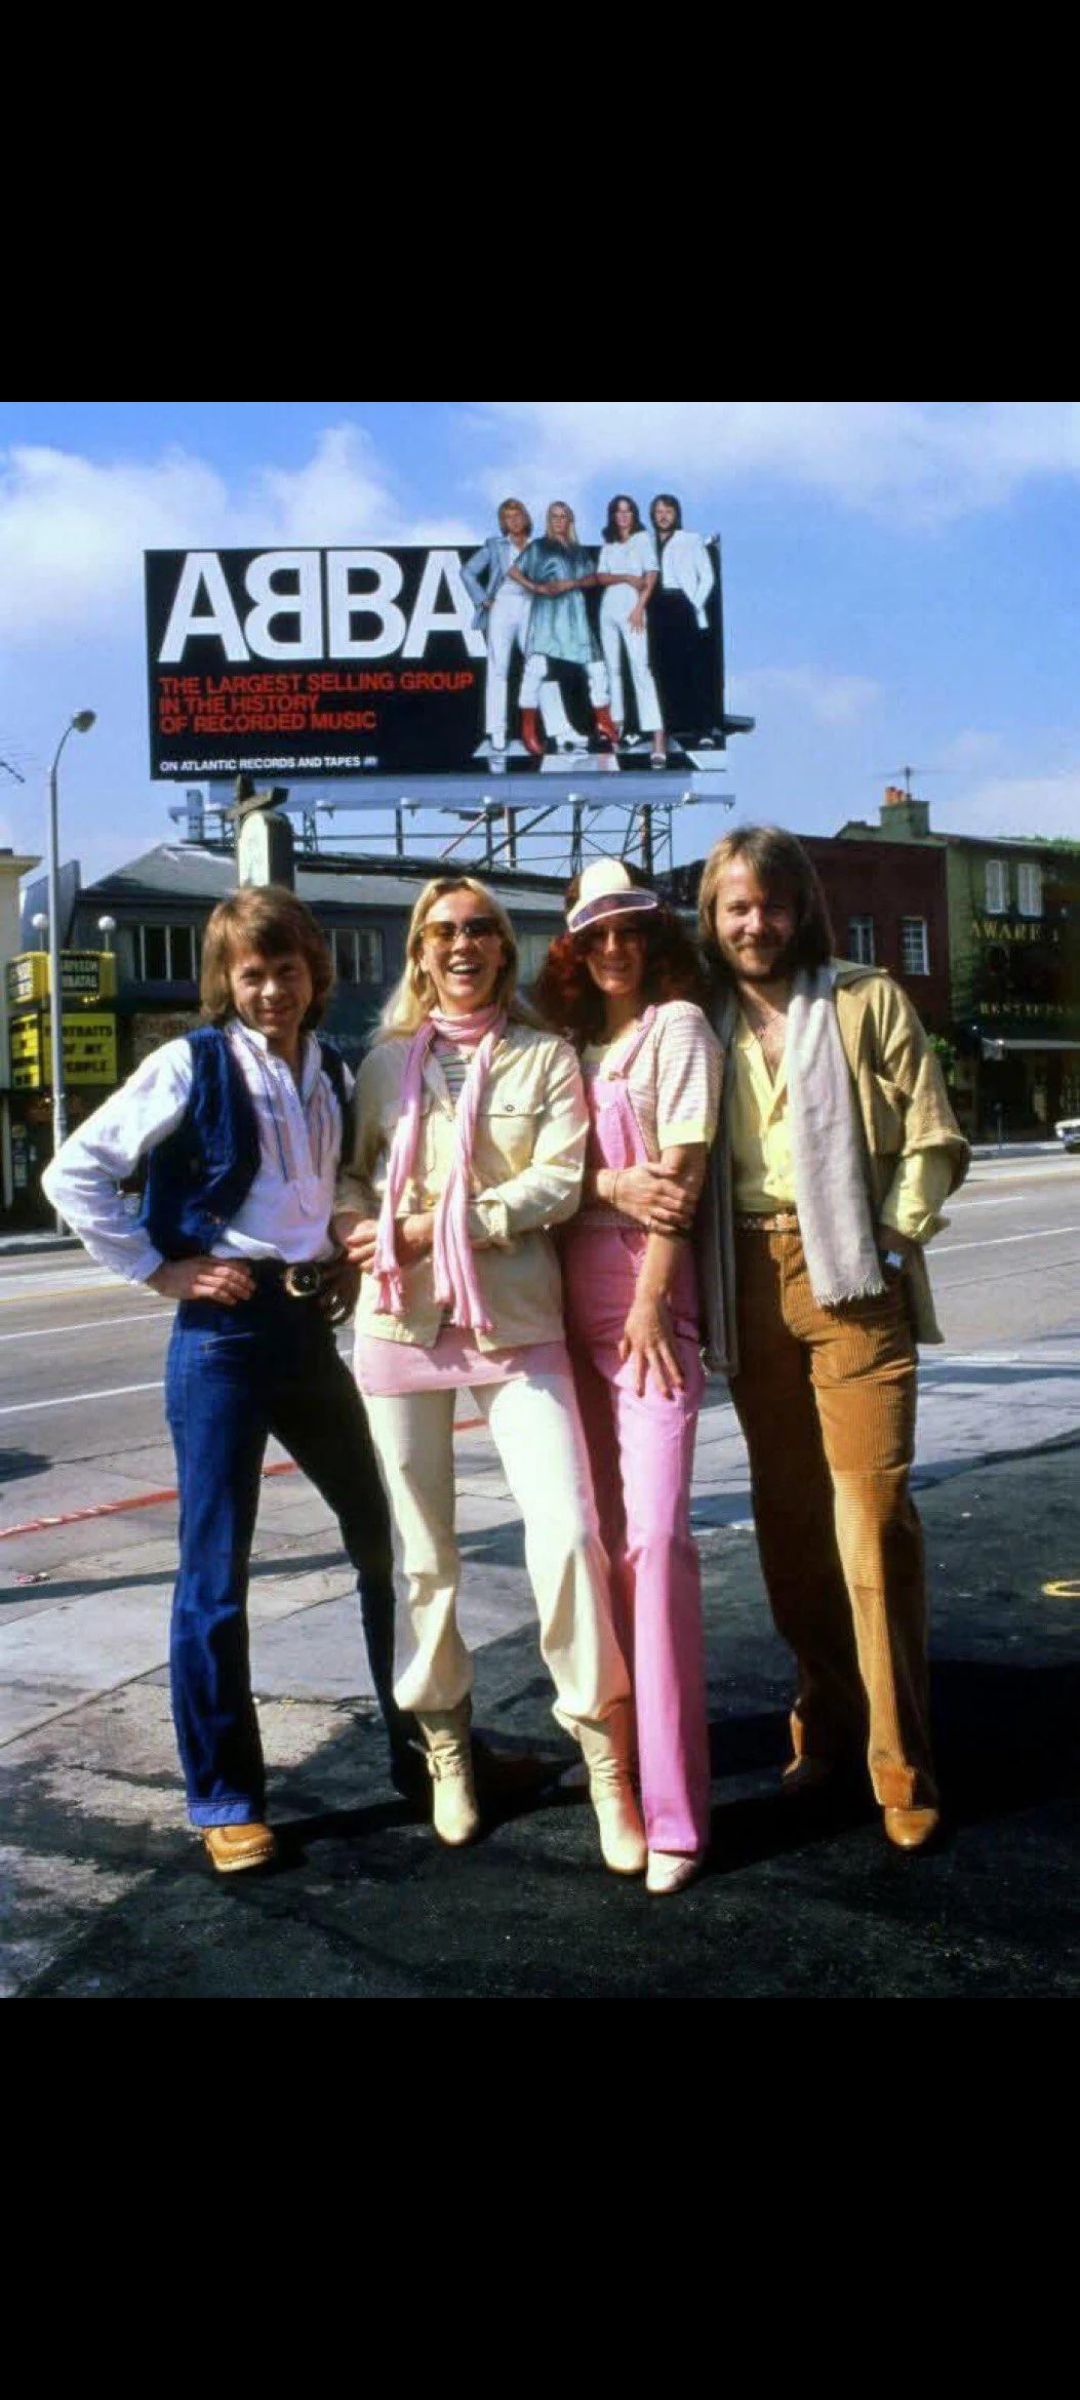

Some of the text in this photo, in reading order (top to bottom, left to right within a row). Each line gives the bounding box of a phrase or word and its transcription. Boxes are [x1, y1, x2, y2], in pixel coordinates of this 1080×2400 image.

[158, 550, 487, 662] ABBA
[159, 671, 474, 694] THE LARGEST SELLING GROUP
[160, 693, 320, 715] IN THE HISTORY
[160, 711, 377, 734] OF RECORDED MUSIC
[160, 761, 178, 771] ON
[181, 759, 237, 771] ATLANTIC
[239, 757, 295, 770] RECORDS
[298, 757, 322, 768] AND
[324, 756, 361, 767] TAPES
